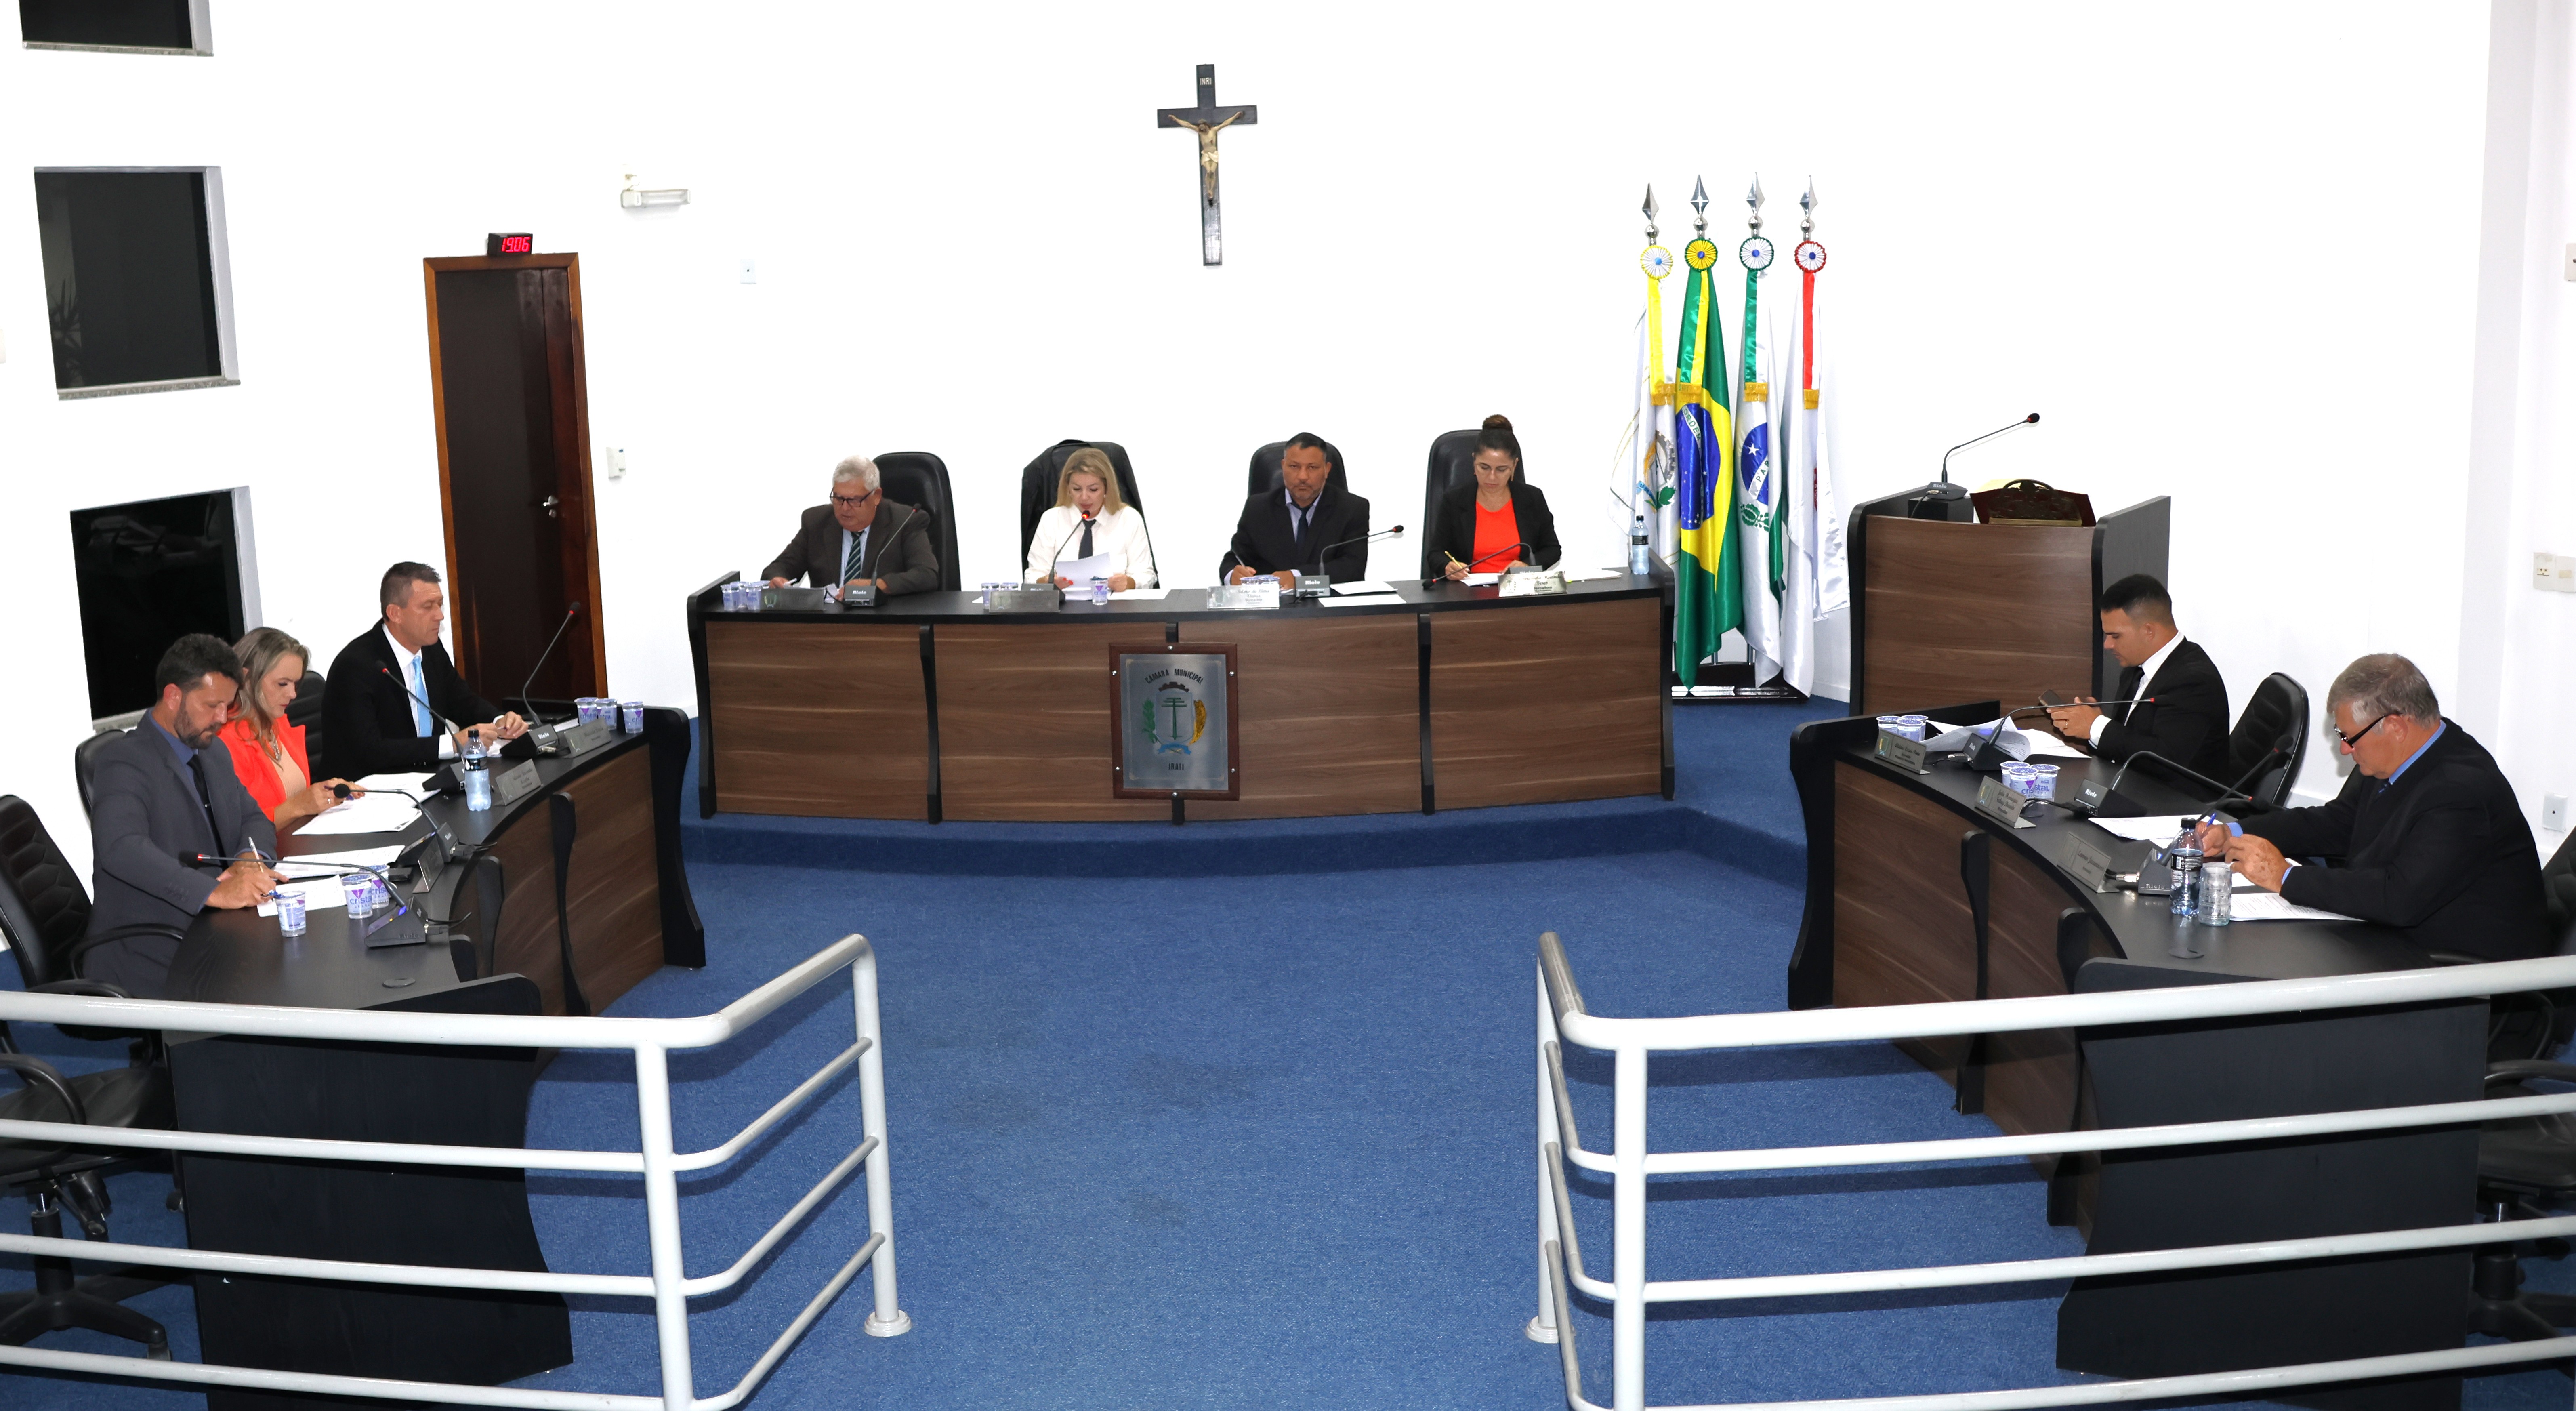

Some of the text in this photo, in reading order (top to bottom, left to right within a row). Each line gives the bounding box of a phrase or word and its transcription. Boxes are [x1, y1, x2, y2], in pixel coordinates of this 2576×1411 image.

[1200, 77, 1212, 85] INRI
[1683, 409, 1701, 441] ORDEM
[1174, 669, 1204, 685] MUNICIPAL
[1168, 762, 1184, 770] IRATI
[2085, 789, 2097, 798] Riole
